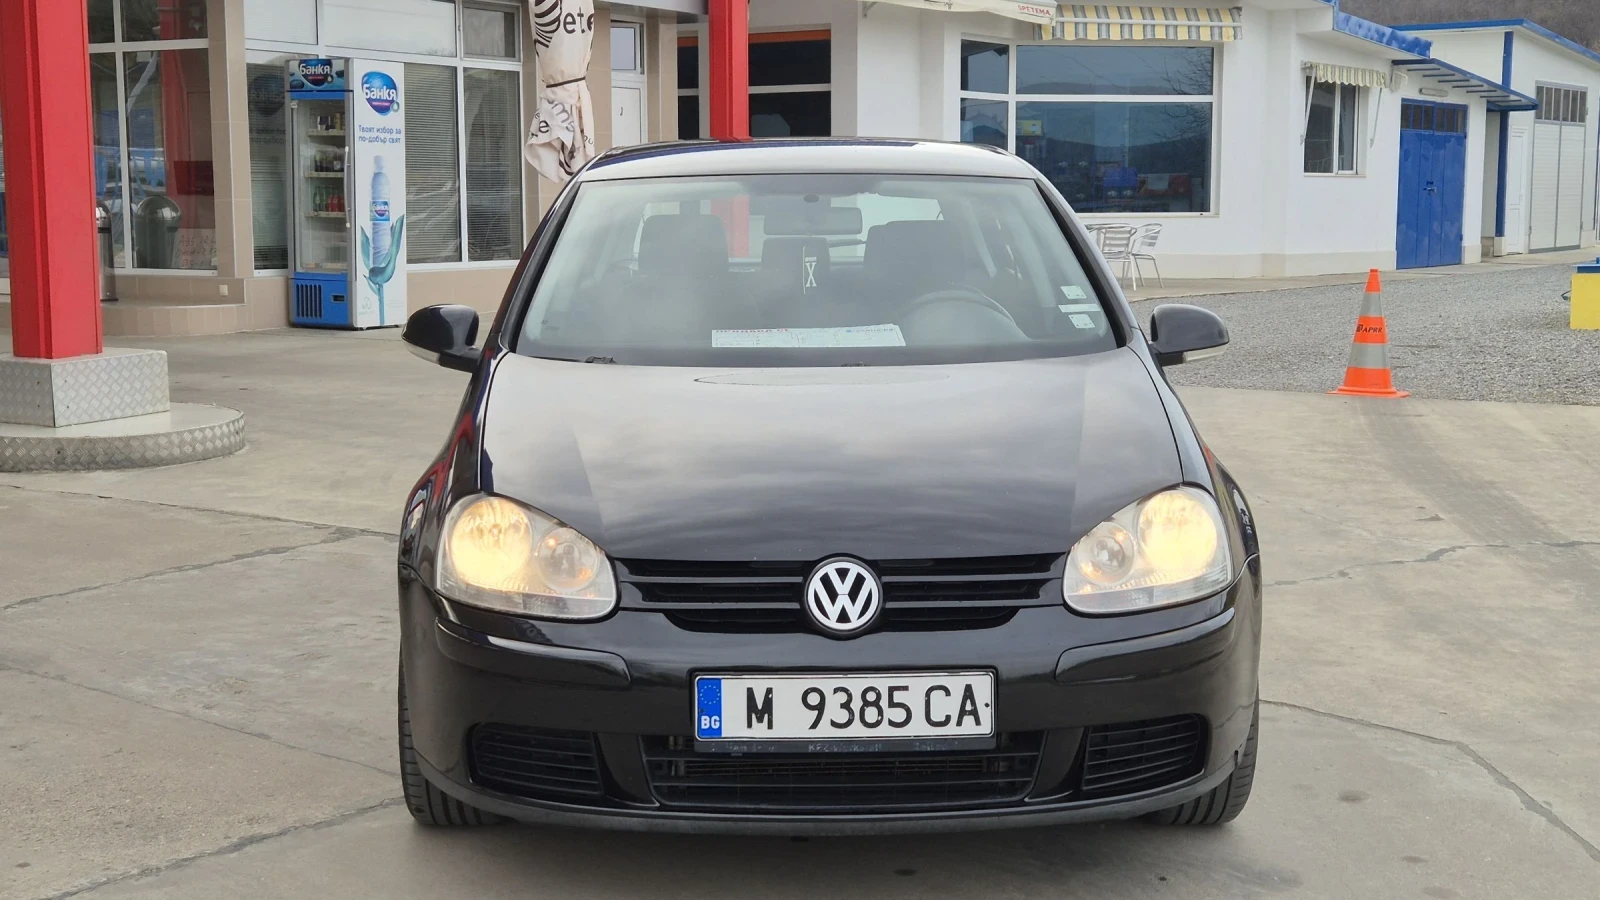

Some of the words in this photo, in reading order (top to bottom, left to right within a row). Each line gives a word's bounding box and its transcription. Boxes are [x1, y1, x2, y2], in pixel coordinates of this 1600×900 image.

[1018, 5, 1051, 16] SPETEMA
[358, 124, 375, 133] Твоят
[376, 126, 394, 135] избор
[358, 135, 387, 144] по-добър
[746, 687, 774, 730] M
[801, 686, 913, 730] 9385
[924, 683, 982, 728] CA
[700, 715, 720, 729] BG
